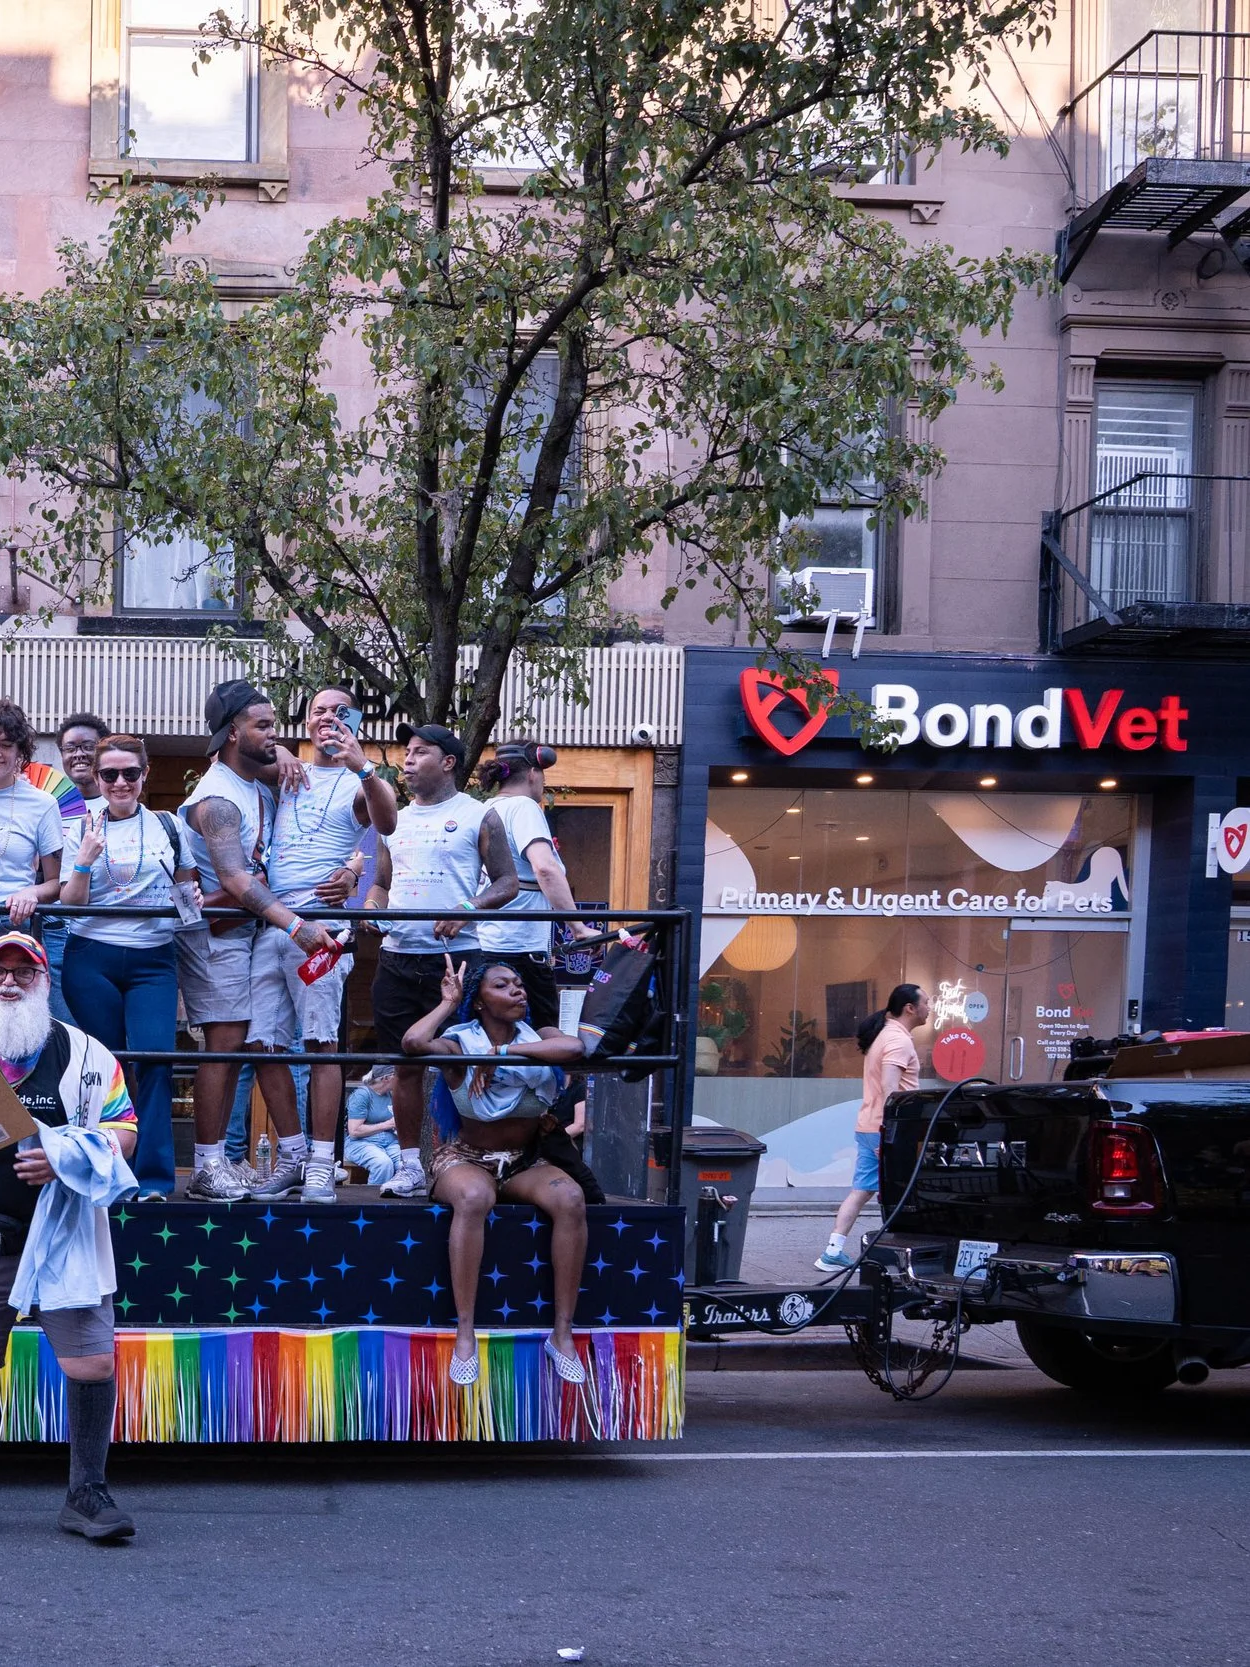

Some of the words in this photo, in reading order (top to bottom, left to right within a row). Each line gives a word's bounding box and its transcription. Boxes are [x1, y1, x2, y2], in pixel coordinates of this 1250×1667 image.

[720, 886, 820, 916] Primary
[826, 887, 845, 911] &
[851, 888, 941, 916] Urgent
[947, 889, 1008, 912] Care
[1014, 888, 1048, 912] for
[1058, 890, 1113, 914] Pets
[1038, 1022, 1054, 1030] Open
[940, 1032, 959, 1045] Take
[960, 1032, 975, 1045] One
[703, 1304, 771, 1325] Trailers
